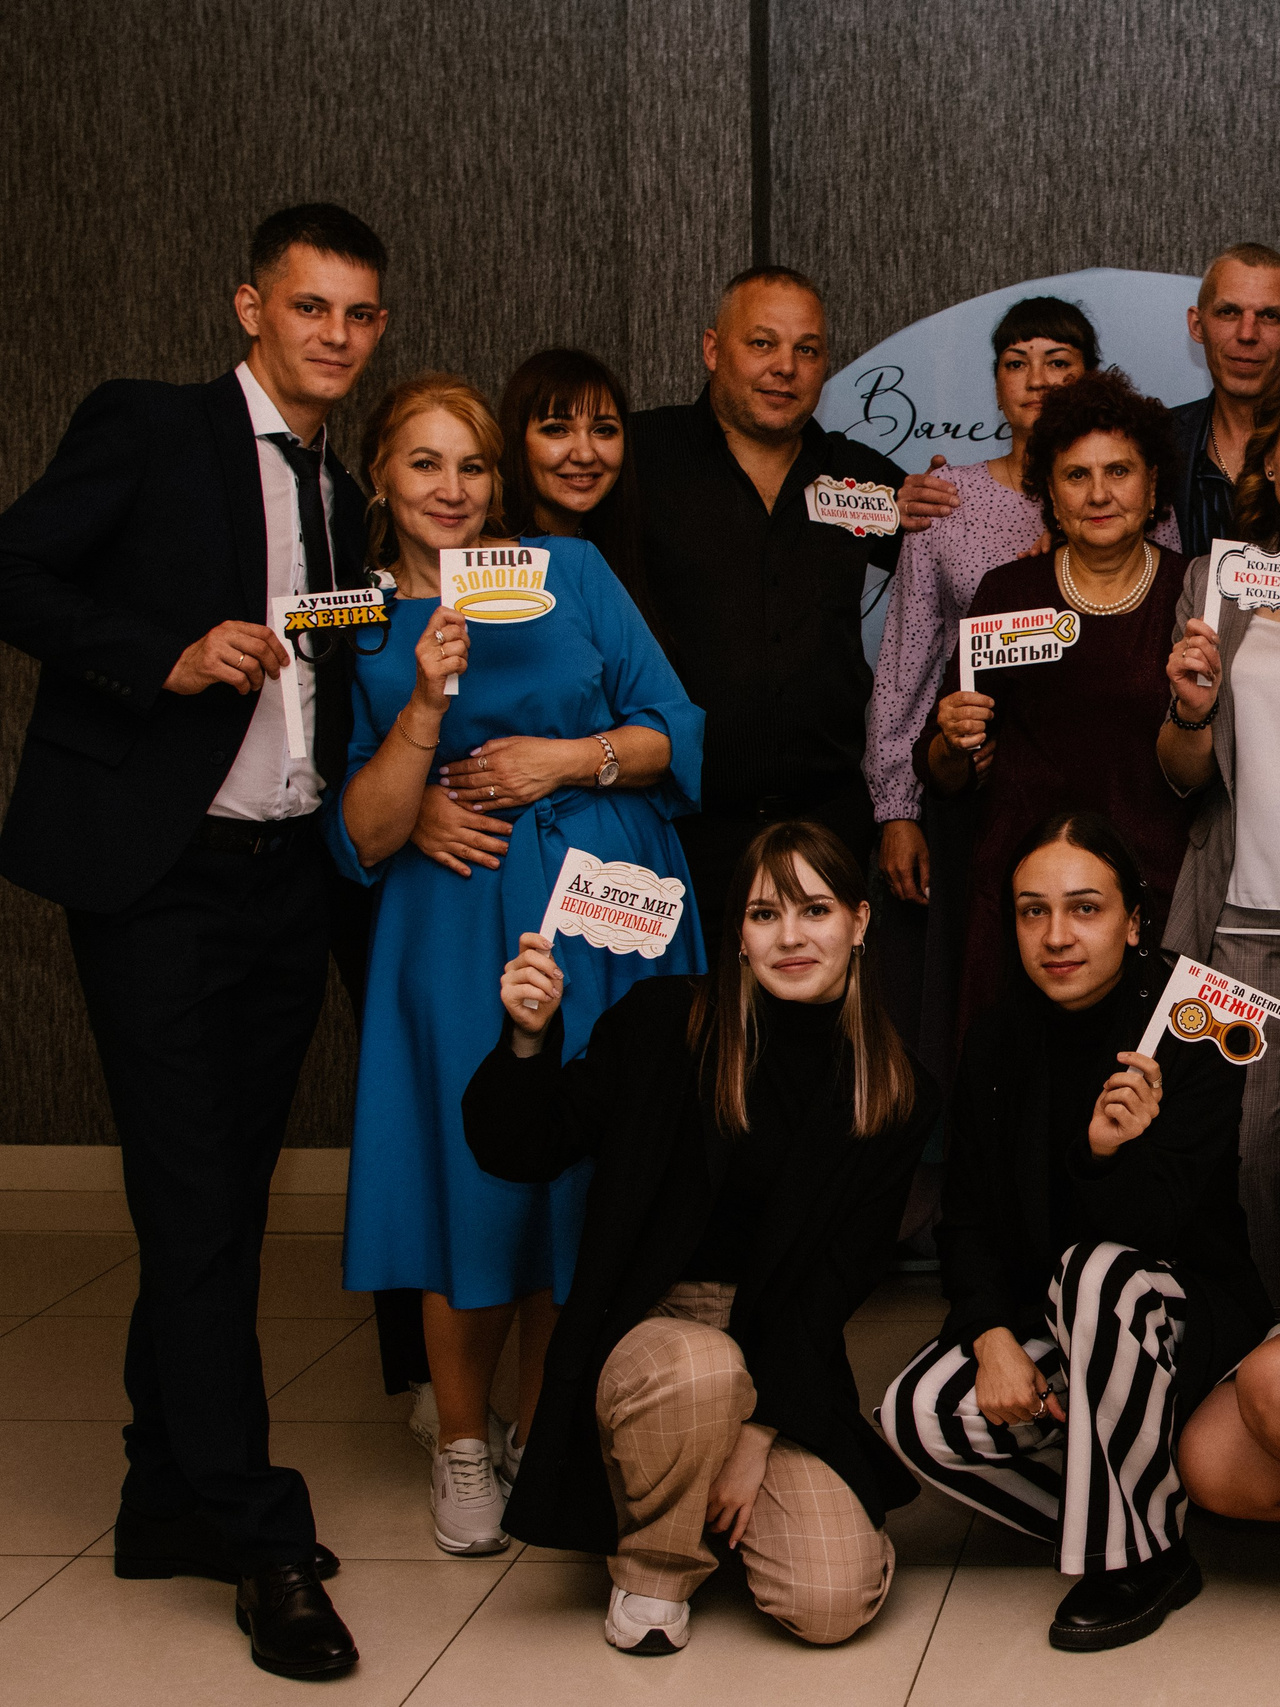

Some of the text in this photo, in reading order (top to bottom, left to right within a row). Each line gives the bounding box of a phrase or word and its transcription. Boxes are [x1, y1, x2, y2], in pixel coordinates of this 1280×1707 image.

[843, 365, 1013, 457] Вячес
[818, 492, 893, 514] О БОЖЕ,
[820, 508, 894, 522] КАКОЙ МУЖЧИНА!
[462, 549, 533, 568] ТЕЩА
[452, 568, 544, 593] ЗОЛОТАЯ
[284, 604, 389, 630] ЖЕНИХ
[970, 613, 1054, 635] ИЩУ КЛЮЧ
[970, 634, 993, 651] ОТ
[970, 643, 1059, 668] СЧАСТЬЯ!
[568, 873, 678, 917] АХ, ЭТОТ МИГ
[560, 895, 668, 938] НЕПОВТОРИМЫЙ...
[1188, 965, 1203, 978] НЕ
[1205, 972, 1229, 992] ПЬЮ.
[1231, 985, 1246, 998] ЗА
[1197, 983, 1265, 1025] СЛЕЖУ!
